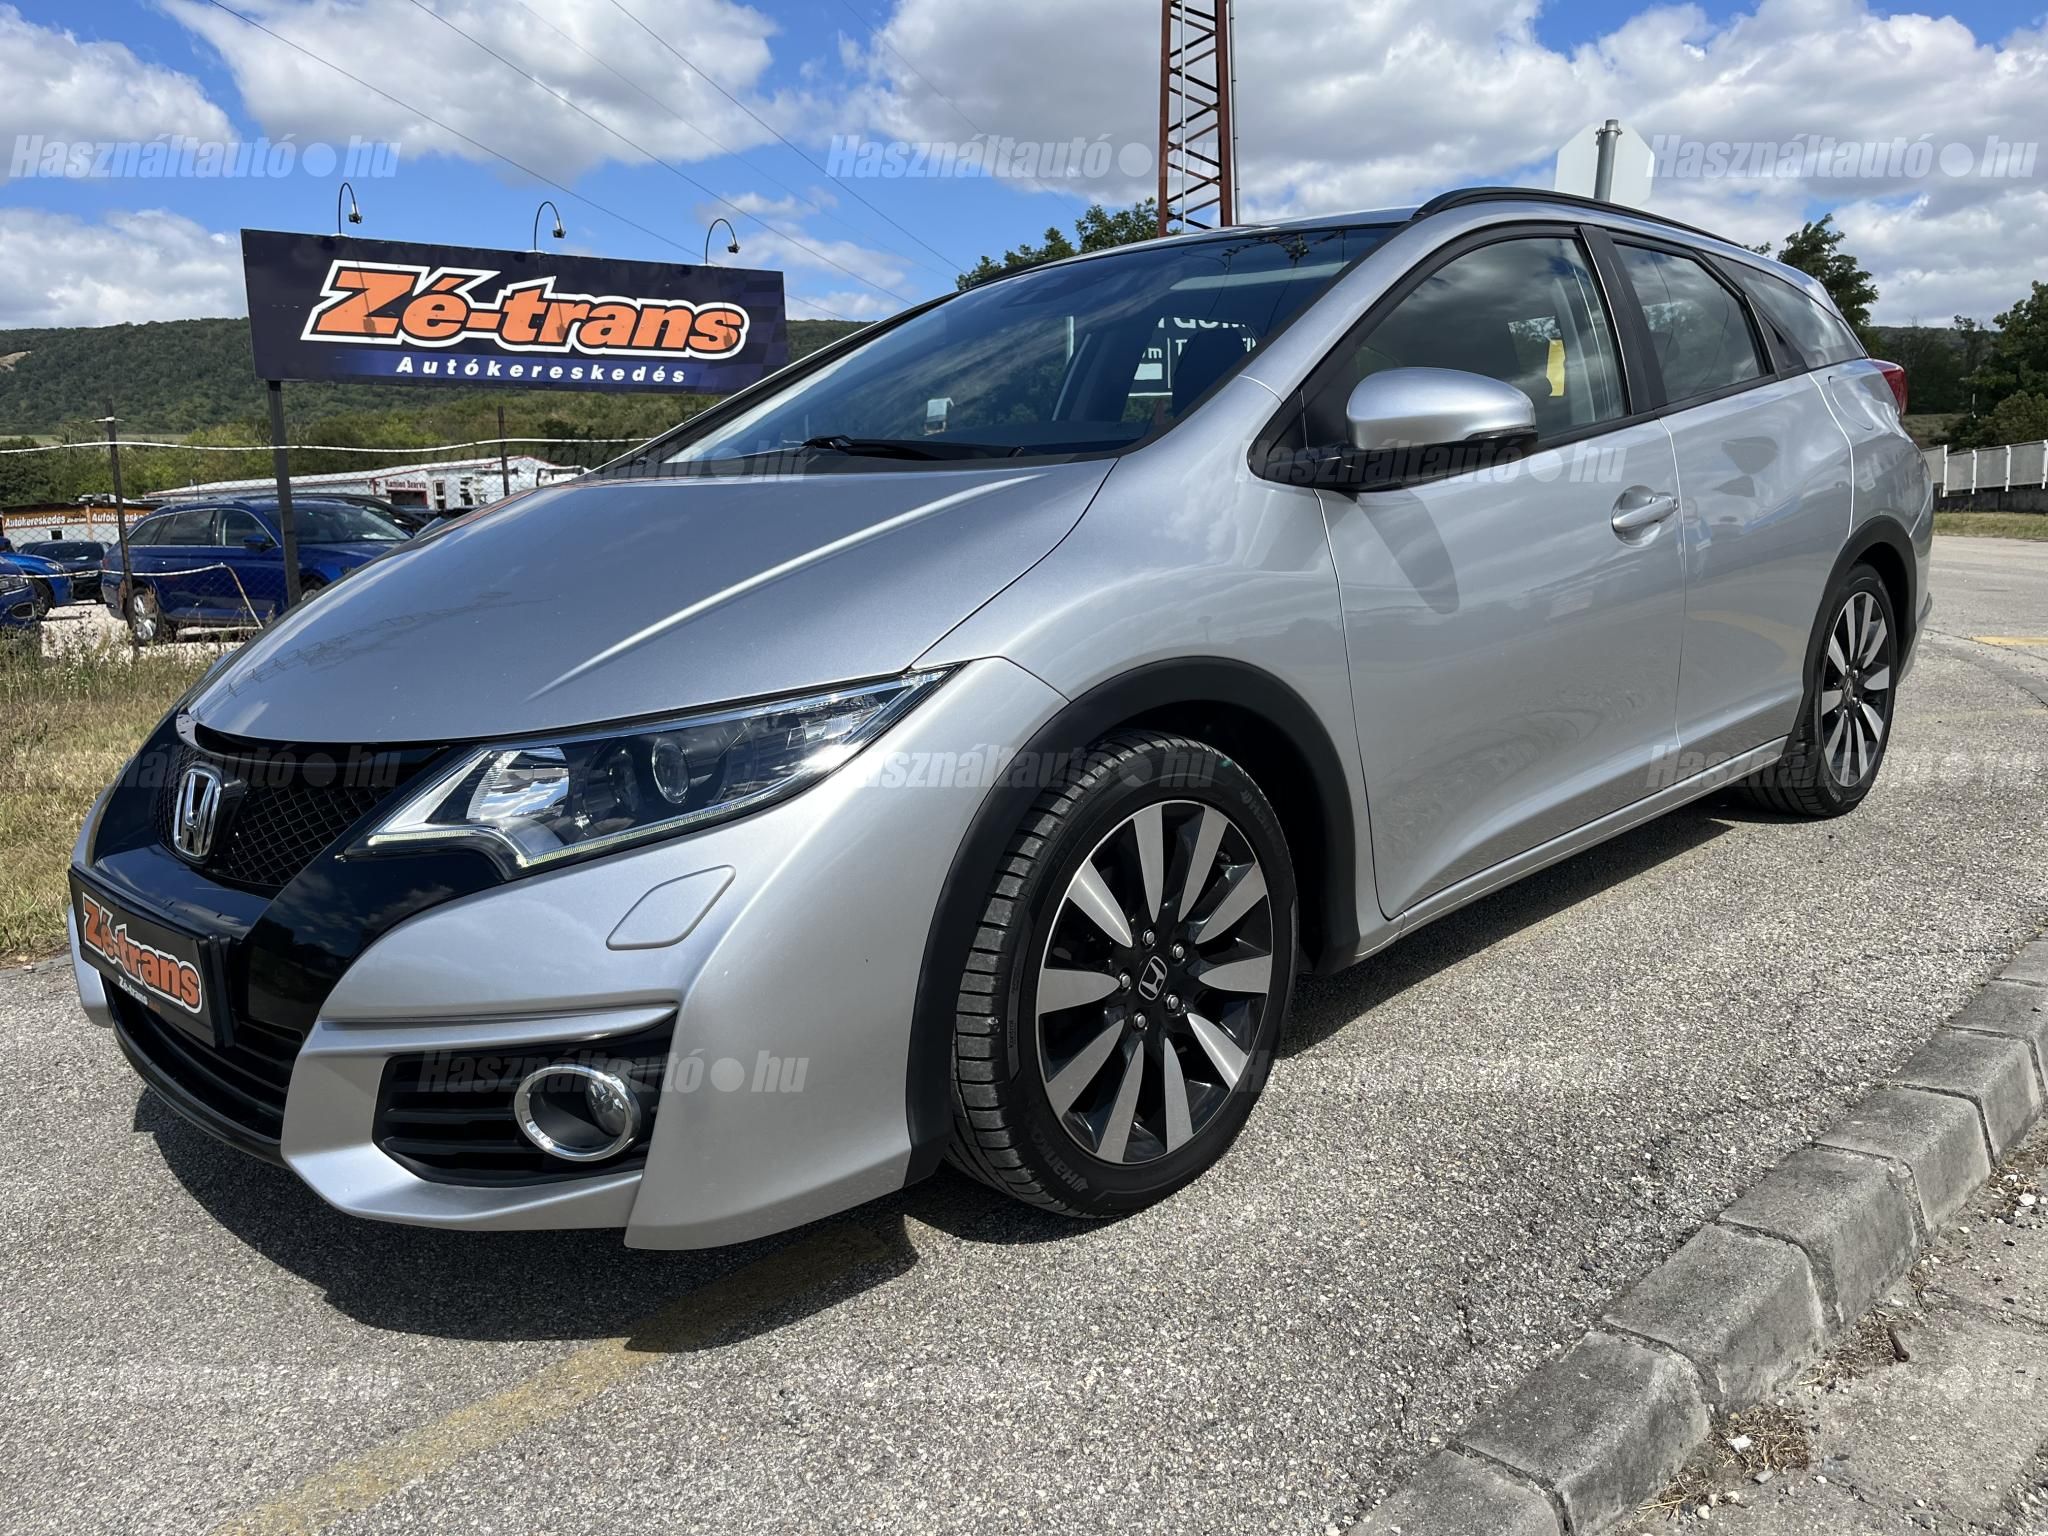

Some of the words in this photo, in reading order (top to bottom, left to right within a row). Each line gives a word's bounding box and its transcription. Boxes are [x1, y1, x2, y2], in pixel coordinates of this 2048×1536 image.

[302, 261, 749, 358] Zé-trans
[396, 356, 685, 383] Autókereskedés
[82, 892, 202, 1013] Zé-trans
